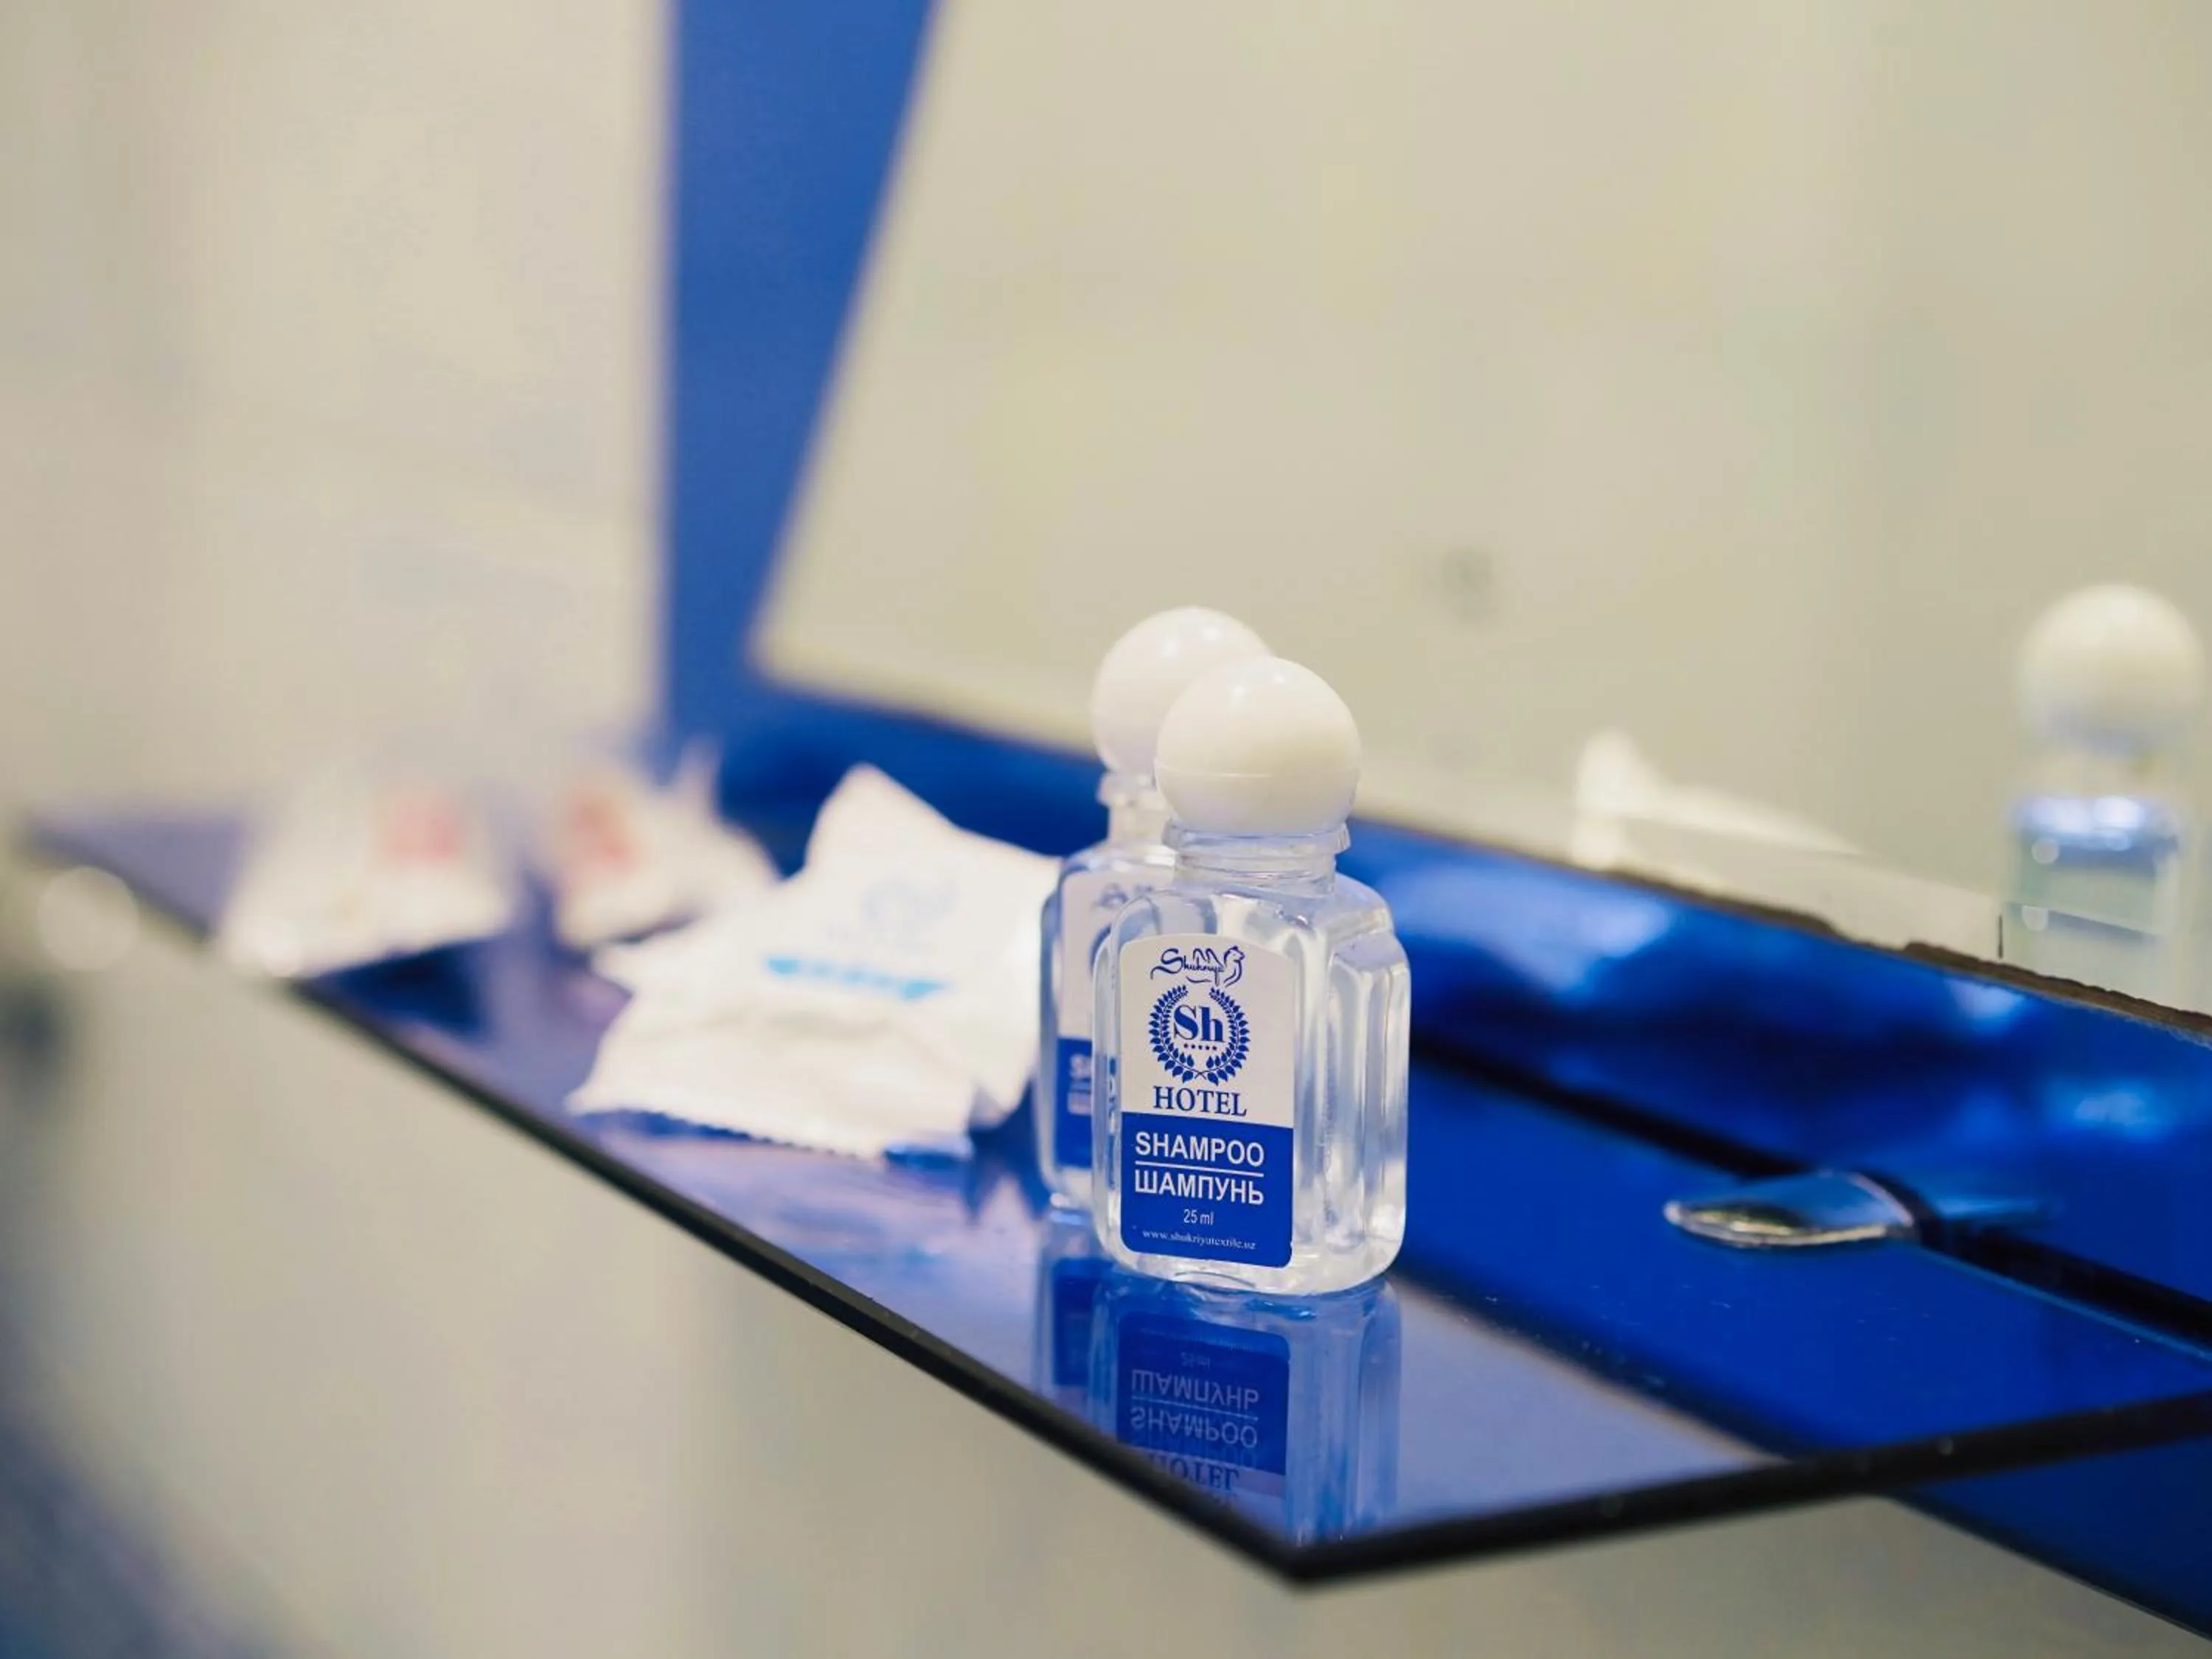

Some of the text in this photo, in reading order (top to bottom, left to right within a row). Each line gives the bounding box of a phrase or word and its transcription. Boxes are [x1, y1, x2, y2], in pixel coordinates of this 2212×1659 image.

[1173, 1004, 1225, 1043] Sh
[1152, 1085, 1248, 1117] HOTEL
[1135, 1131, 1265, 1167] SHAMPOO
[1134, 1169, 1265, 1206] ШАМПУНЬ
[1183, 1208, 1214, 1226] 25 ml
